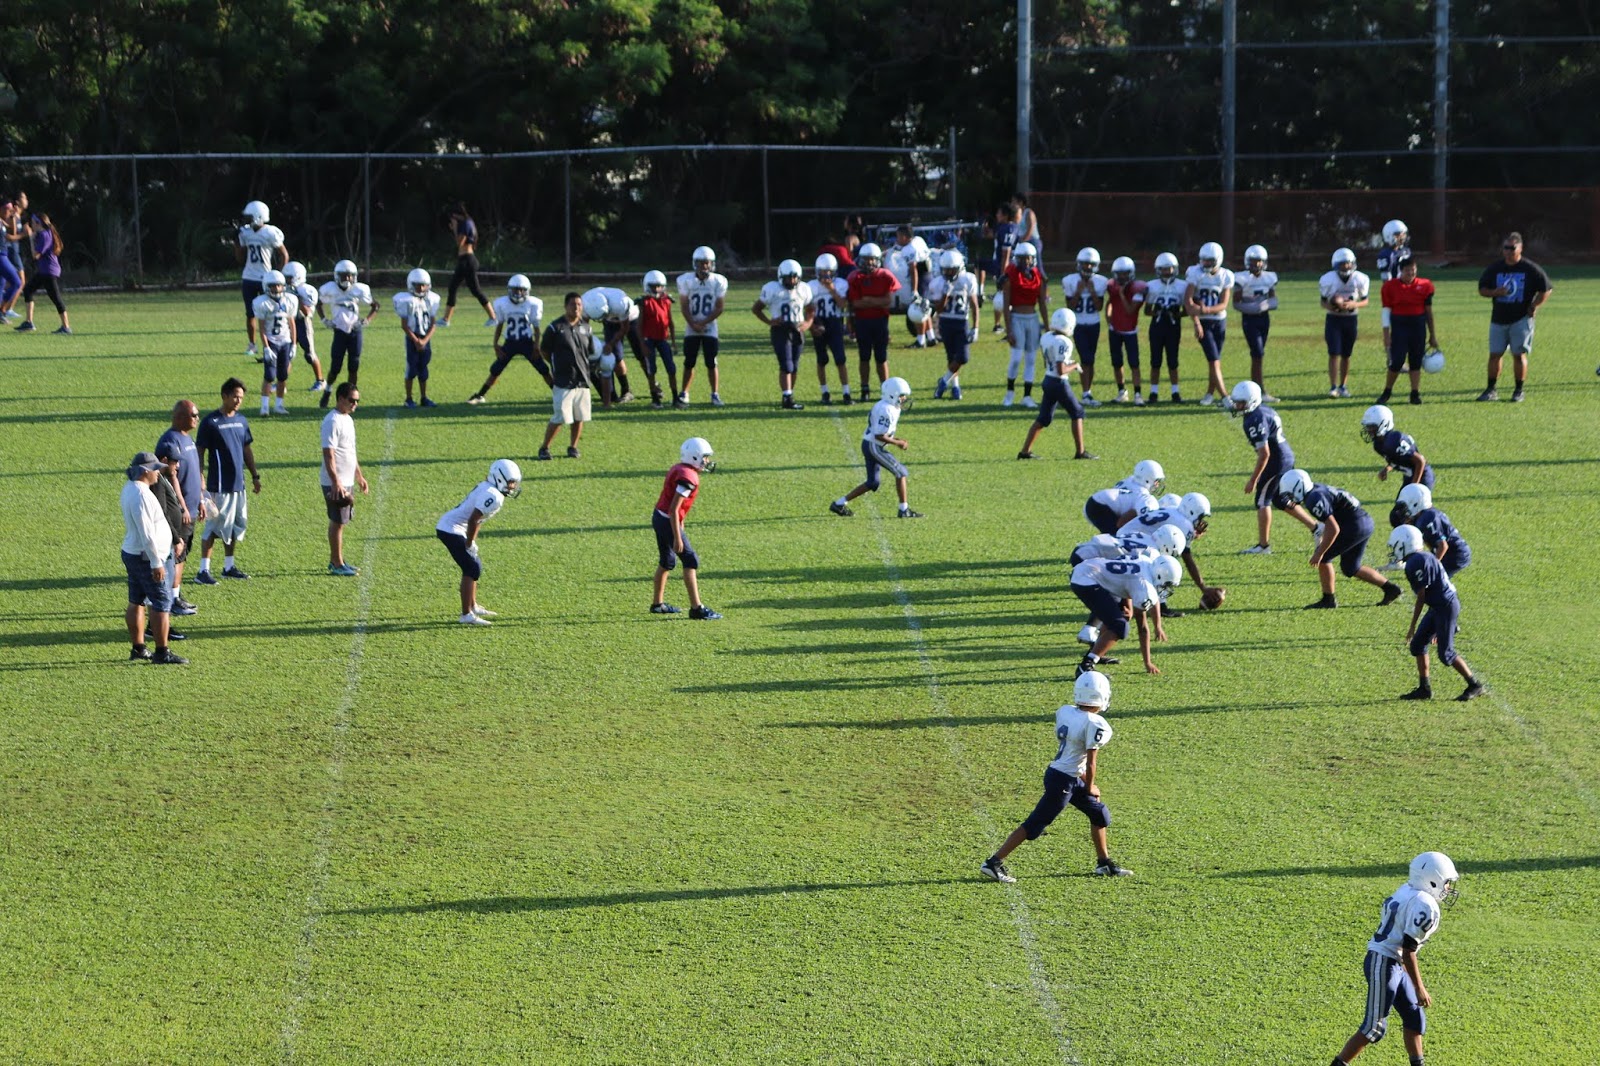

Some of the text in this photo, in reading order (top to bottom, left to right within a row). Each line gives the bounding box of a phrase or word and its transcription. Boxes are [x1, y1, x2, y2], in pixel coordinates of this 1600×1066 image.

[690, 294, 713, 316] 36
[817, 298, 838, 318] 83
[506, 316, 529, 340] 22
[483, 497, 493, 508] 8
[1094, 728, 1104, 743] 6
